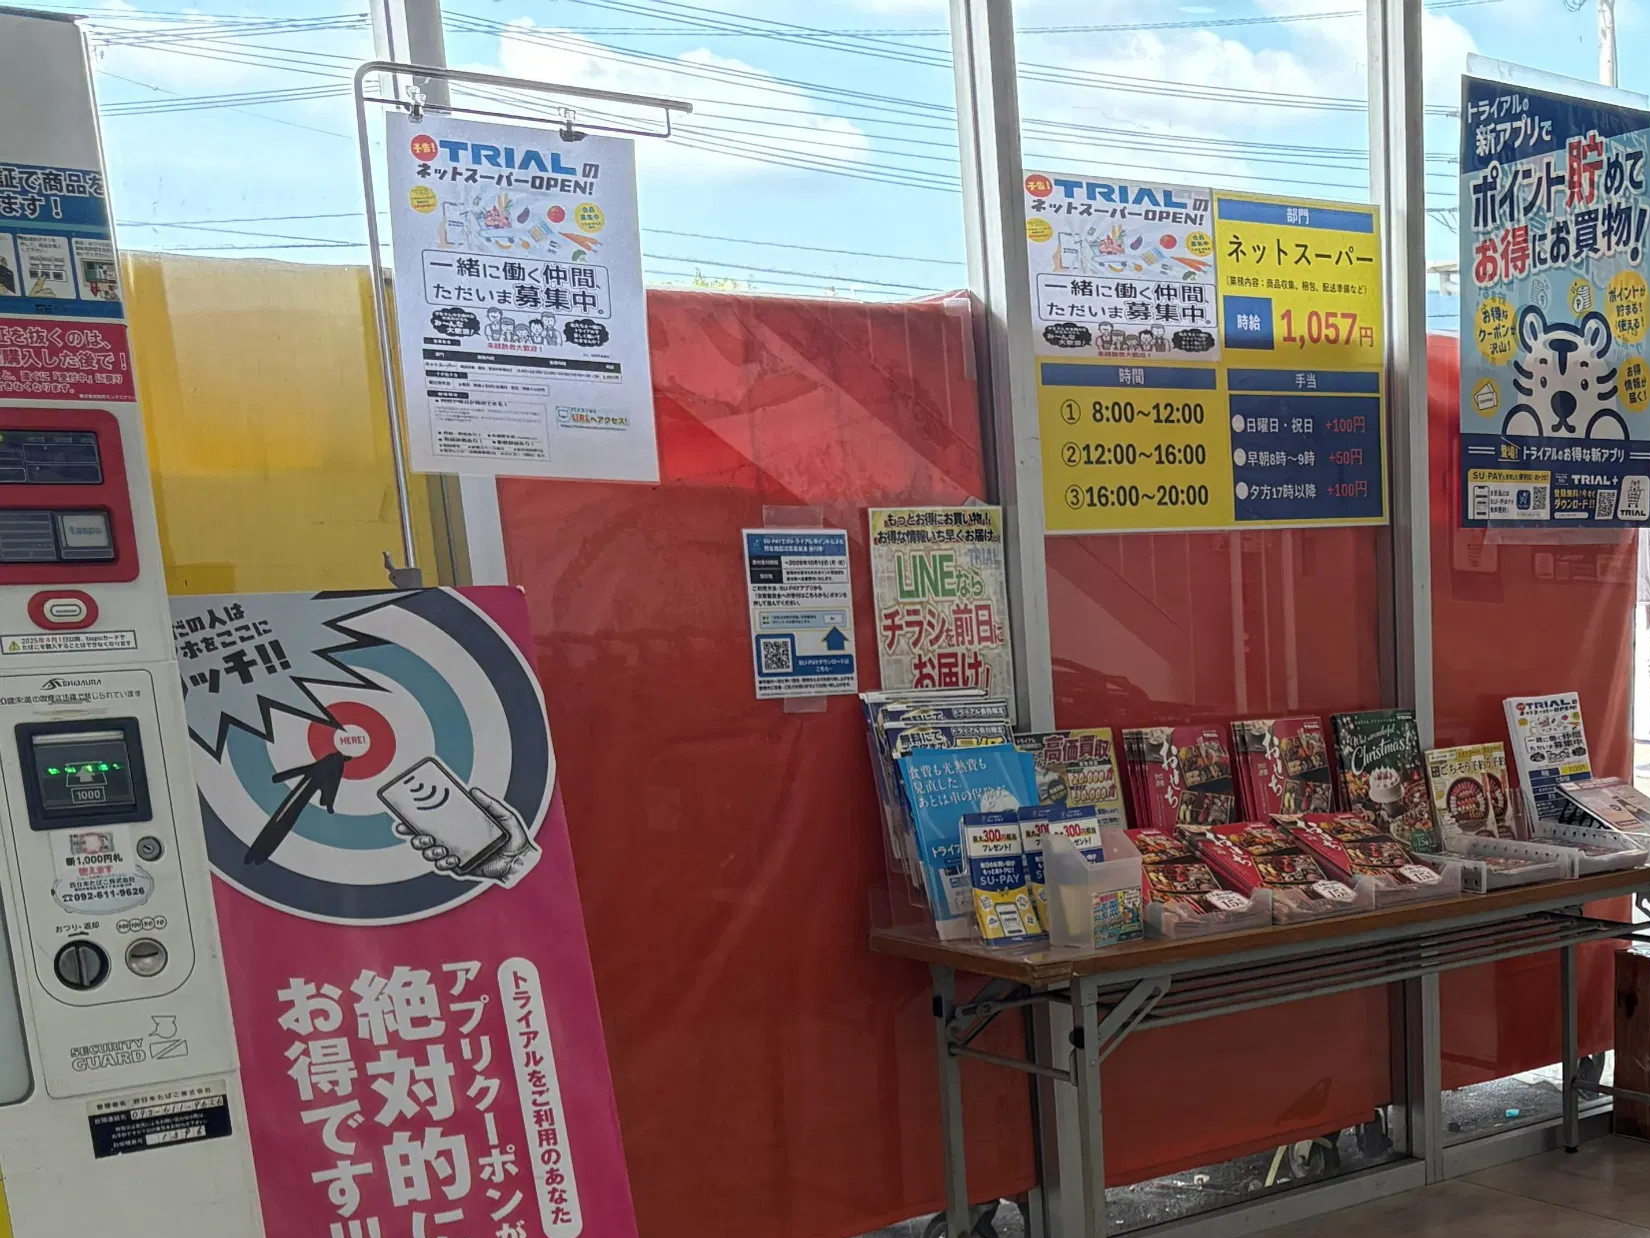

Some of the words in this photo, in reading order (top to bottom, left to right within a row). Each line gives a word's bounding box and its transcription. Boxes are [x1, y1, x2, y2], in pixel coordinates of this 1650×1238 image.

[1475, 113, 1552, 157] 新アプリで
[416, 163, 595, 196] ネットスーパーOPEN!
[1472, 131, 1645, 229] ポイント貯めて
[1031, 199, 1205, 226] ネットスーパーOPEN!
[1286, 207, 1310, 225] 部門
[1227, 234, 1374, 266] ネットスーパー
[1475, 201, 1648, 285] お得にお買物!
[430, 257, 602, 290] 一緒に働く仲間、
[433, 284, 605, 316] ただいま募集中。
[1044, 280, 1210, 304] 一緒に働く仲間、
[1047, 302, 1211, 325] ただいま募集中。
[1237, 314, 1261, 331] 時給
[1280, 308, 1374, 349] 1,057円
[1118, 367, 1145, 385] 時間
[1295, 372, 1317, 389] 手当
[1620, 509, 1647, 517] TRIAL
[895, 553, 984, 600] LINEなら
[176, 620, 273, 660] ホをここに
[882, 602, 1004, 651] チラシを前日に
[339, 734, 366, 747] HERE!
[1043, 734, 1112, 763] 高価買取
[1351, 731, 1411, 776] Christmas!
[980, 874, 1020, 886] SU-PAY
[71, 1049, 146, 1072] GUARD
[511, 970, 573, 1226] トライアルをご利用のあなた
